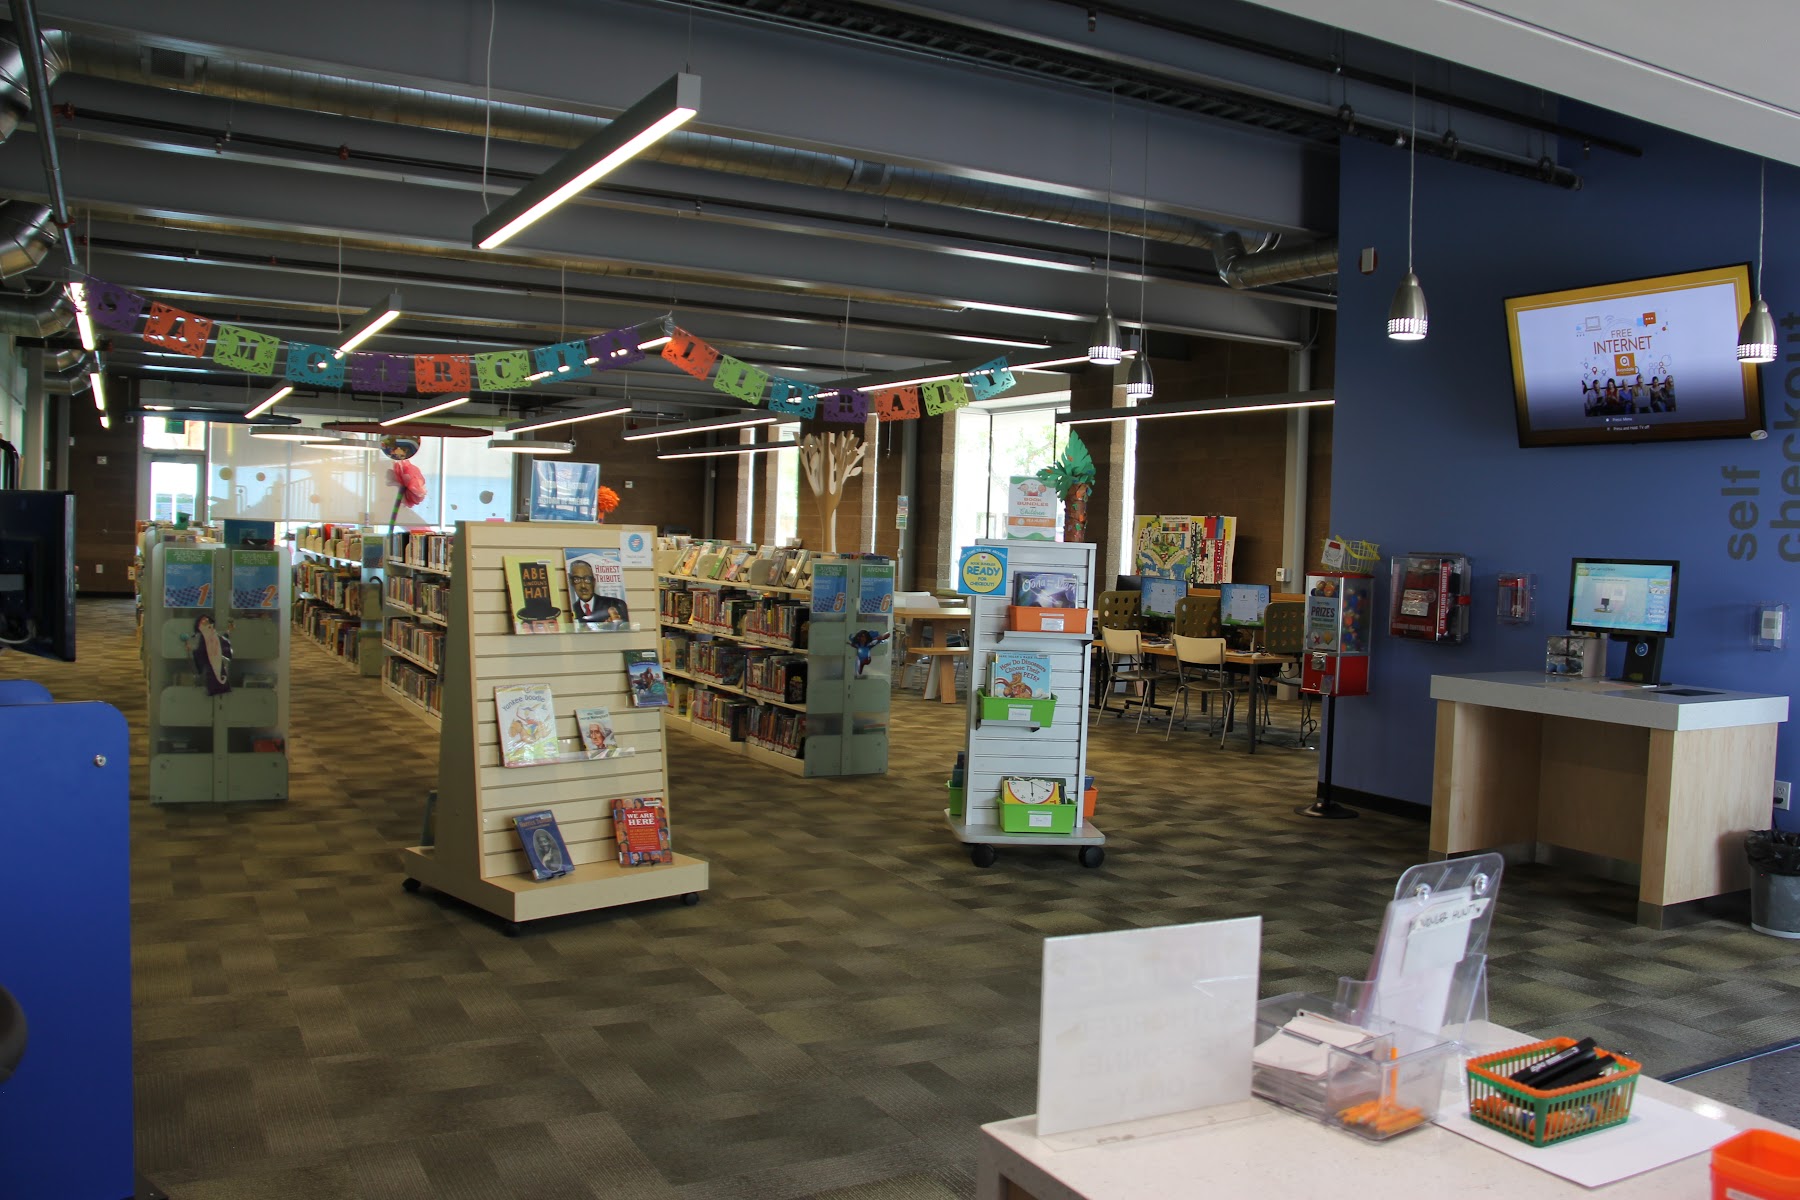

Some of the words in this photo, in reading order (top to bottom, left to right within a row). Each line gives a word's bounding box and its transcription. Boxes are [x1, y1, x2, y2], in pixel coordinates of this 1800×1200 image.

[1610, 328, 1632, 338] FREE
[1593, 336, 1652, 354] INTERNET
[1721, 465, 1760, 562] self
[523, 568, 546, 580] ABE
[595, 564, 620, 574] HIGHEST
[966, 566, 1000, 576] READY
[595, 574, 621, 583] TRIBUTE
[197, 583, 210, 606] 1
[262, 584, 277, 607] 2
[525, 586, 548, 599] HAT
[833, 592, 845, 612] 5
[880, 594, 891, 612] 6
[1311, 606, 1335, 618] PRIZES
[999, 662, 1012, 671] How
[1005, 666, 1025, 674] Choose
[1026, 666, 1040, 674] Their
[502, 696, 523, 712] Yankee
[524, 695, 545, 703] Doodle
[628, 818, 655, 826] HERE
